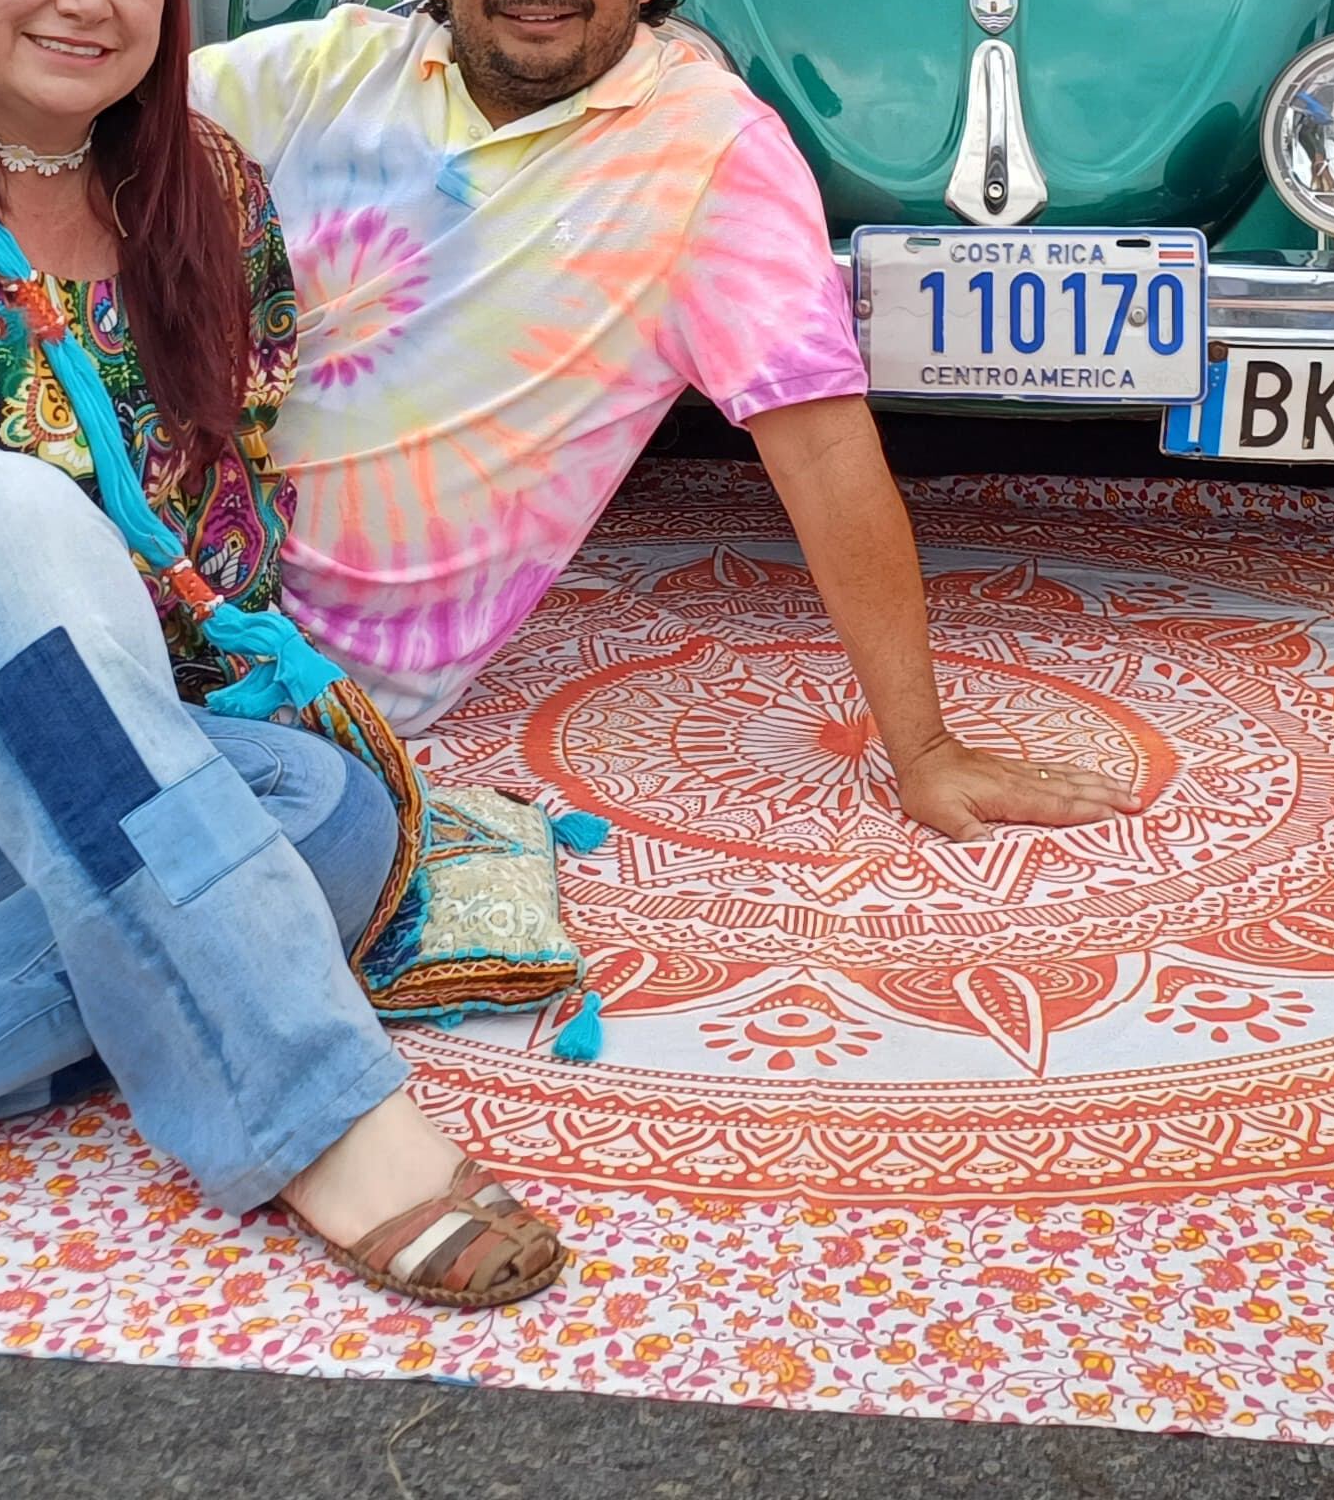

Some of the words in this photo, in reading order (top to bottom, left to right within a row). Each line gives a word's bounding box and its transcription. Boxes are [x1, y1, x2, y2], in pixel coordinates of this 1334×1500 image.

[950, 243, 1034, 264] COSTA
[1047, 243, 1106, 265] RICA
[920, 271, 1185, 357] 110170
[921, 365, 1136, 390] CENTROAMERICA
